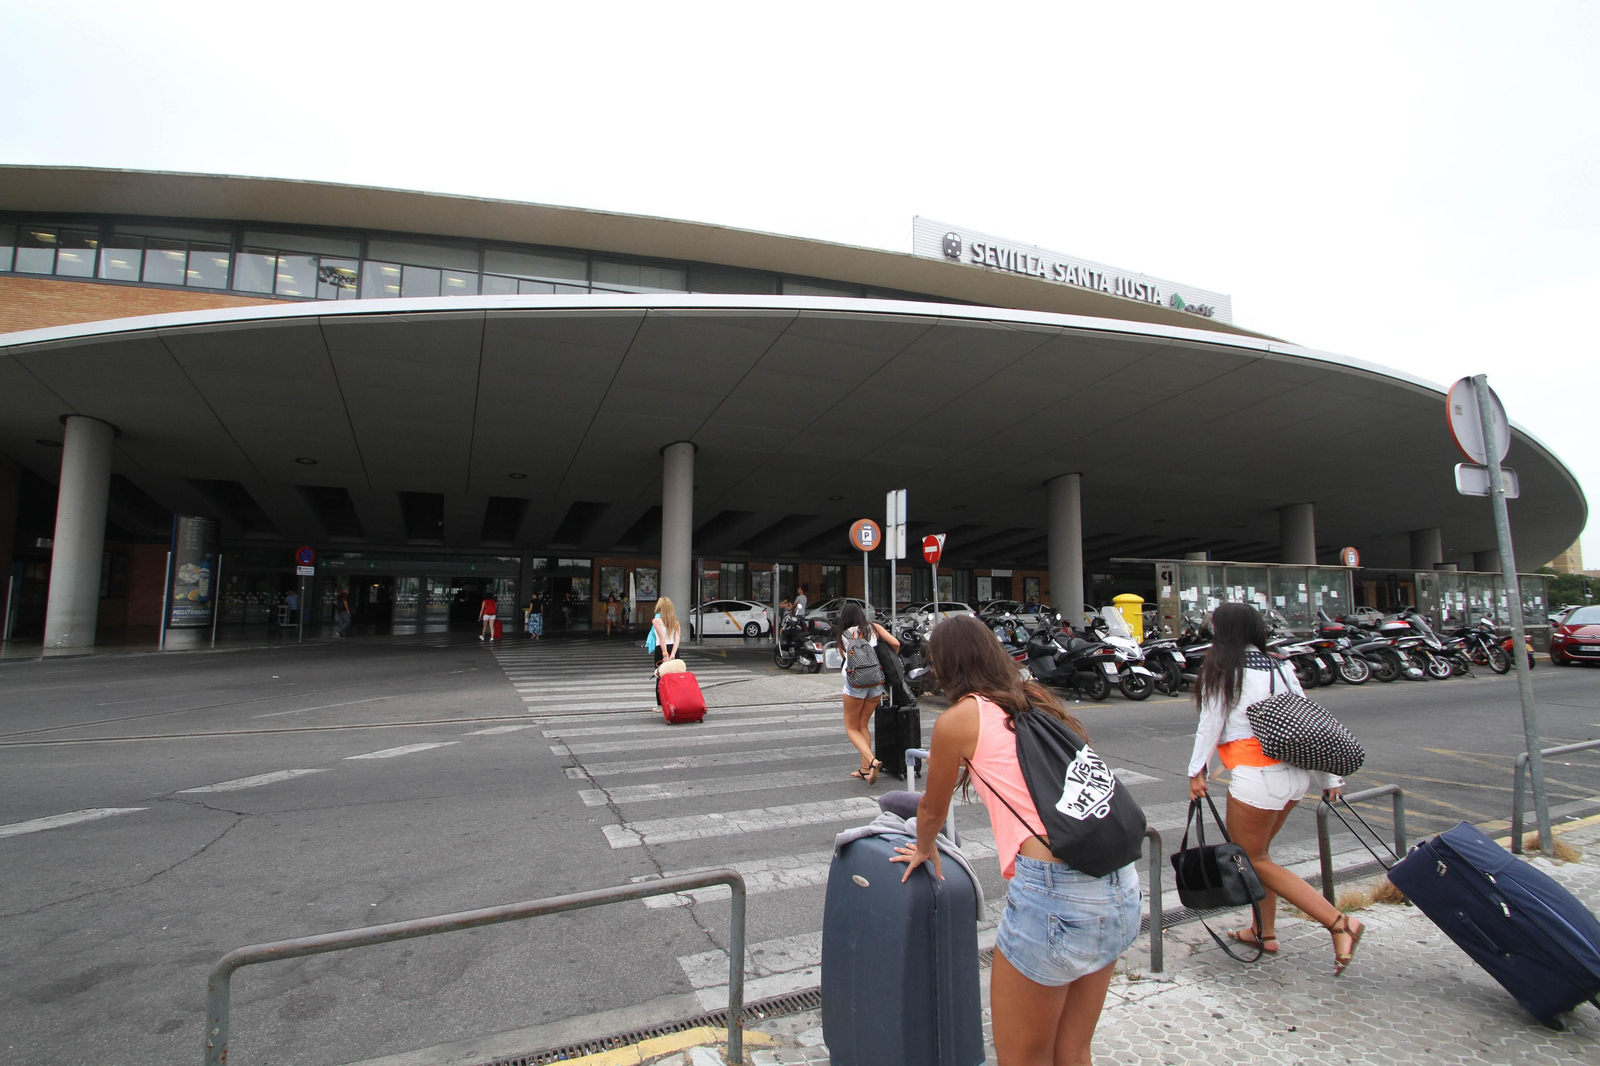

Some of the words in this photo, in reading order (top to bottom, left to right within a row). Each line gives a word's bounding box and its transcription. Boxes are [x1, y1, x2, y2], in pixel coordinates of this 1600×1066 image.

[971, 242, 1049, 278] SEVILLA
[1053, 262, 1110, 293] SANTA
[1115, 275, 1164, 304] JUSTA
